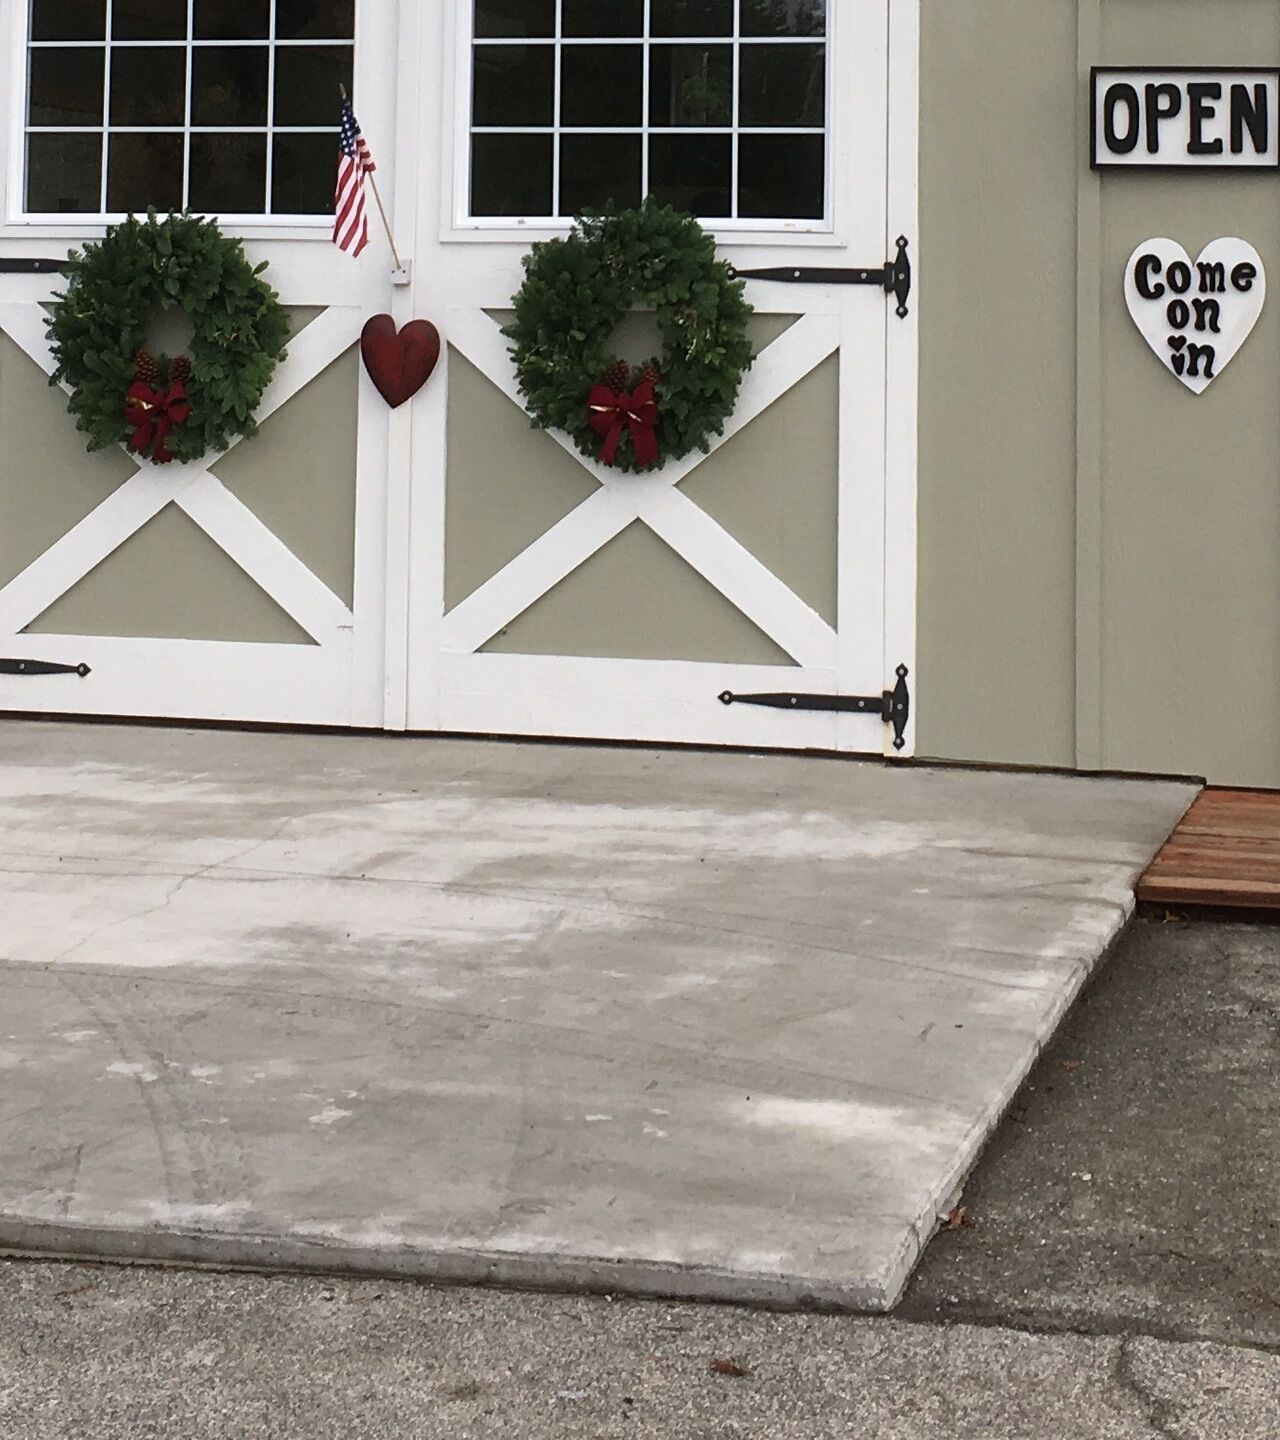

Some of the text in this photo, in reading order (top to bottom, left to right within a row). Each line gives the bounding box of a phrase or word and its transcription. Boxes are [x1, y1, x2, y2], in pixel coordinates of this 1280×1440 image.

[1103, 82, 1268, 155] OPEN
[1133, 253, 1257, 300] Come
[1166, 297, 1221, 333] on
[1167, 334, 1215, 379] in
